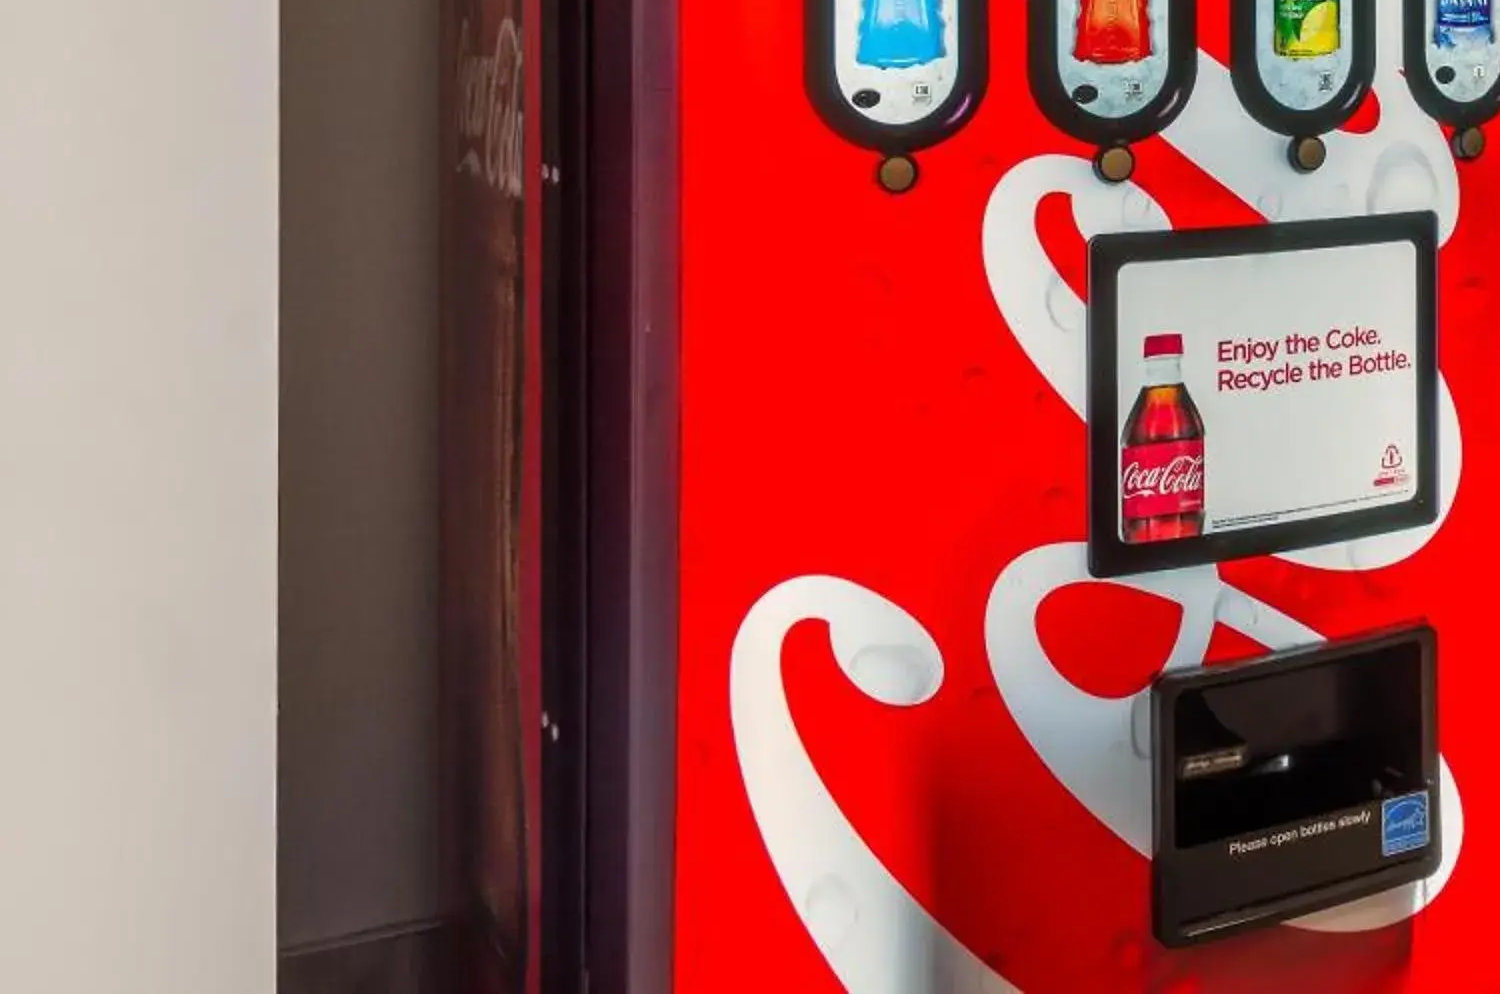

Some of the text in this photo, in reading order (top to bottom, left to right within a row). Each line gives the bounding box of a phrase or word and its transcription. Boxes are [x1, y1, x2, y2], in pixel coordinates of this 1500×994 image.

[1217, 326, 1382, 364] Enjoy the Coke.
[1217, 350, 1412, 392] Recycle the Bottle.
[1122, 454, 1203, 499] Coca-Cola
[1229, 836, 1268, 855] Please
[1270, 829, 1299, 847] open
[1299, 821, 1337, 838] bottles
[1337, 810, 1371, 828] slowly
